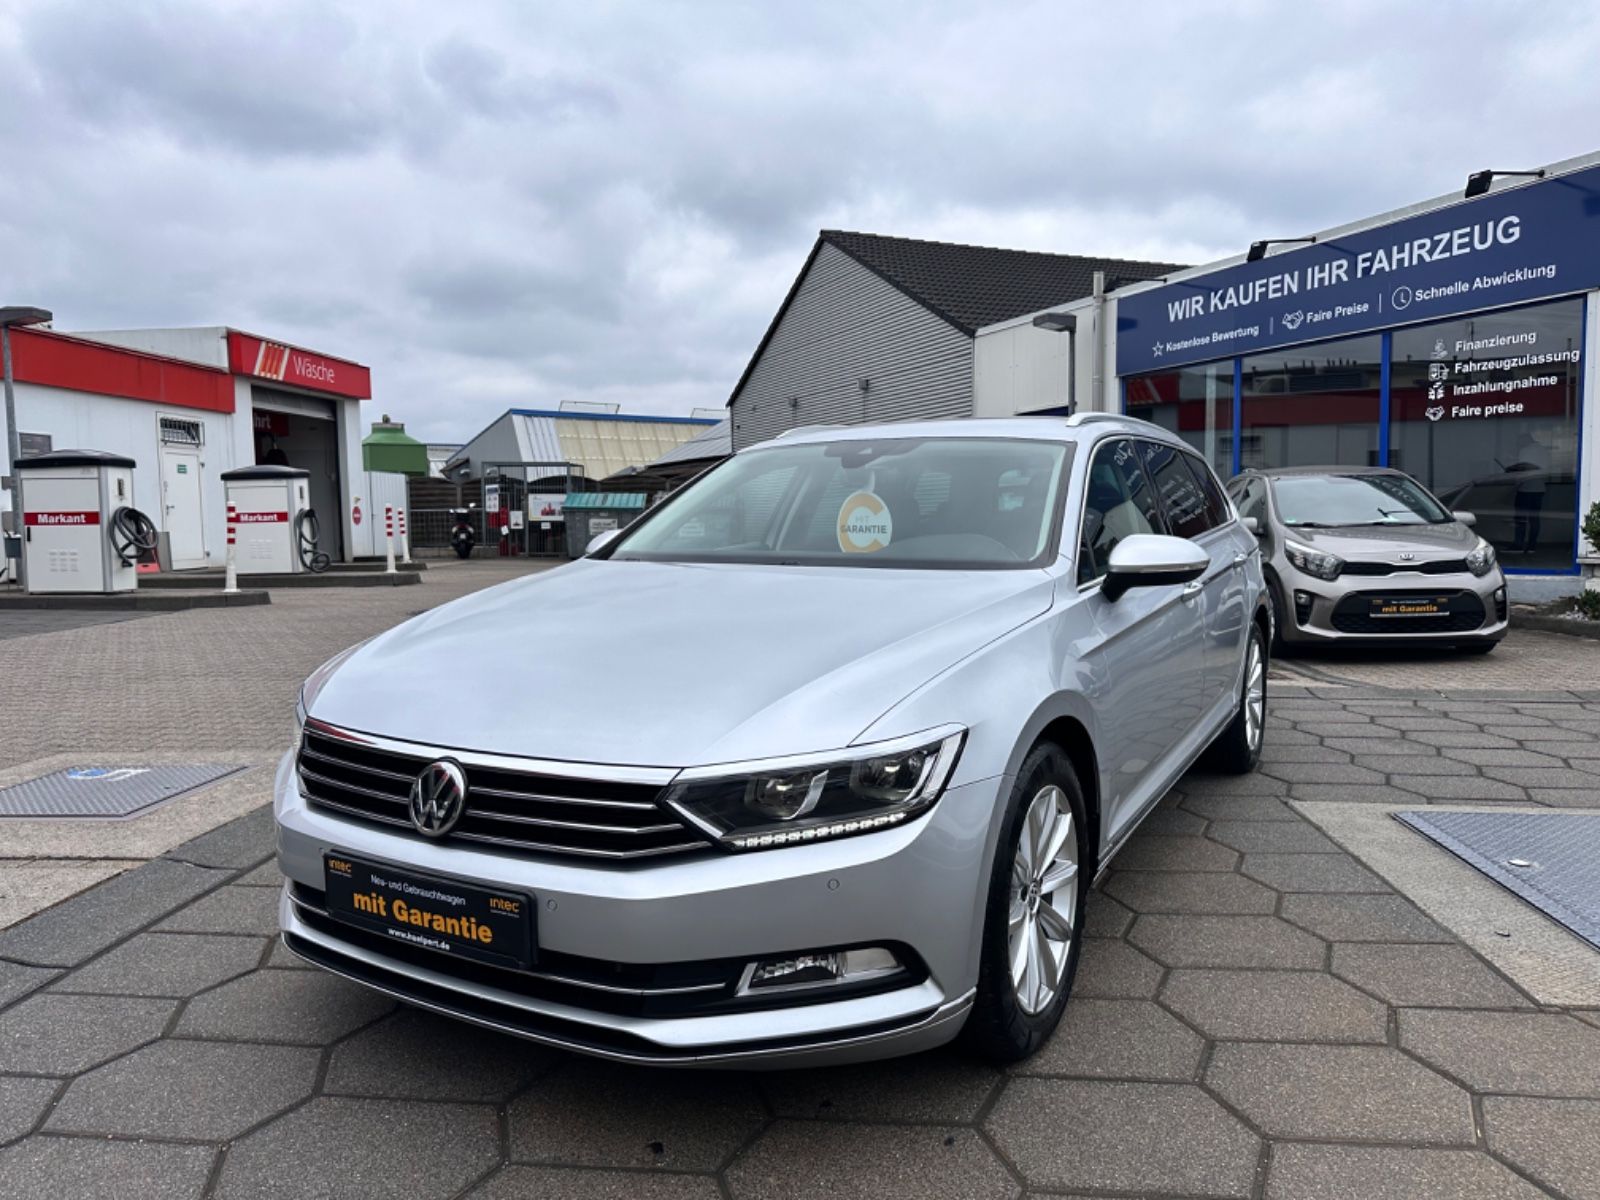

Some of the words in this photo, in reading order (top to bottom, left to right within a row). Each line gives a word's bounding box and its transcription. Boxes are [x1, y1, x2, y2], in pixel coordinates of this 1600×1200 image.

[1168, 296, 1205, 323] WIR
[1210, 271, 1299, 313] KAUFEN
[1306, 259, 1349, 290] IHR
[1356, 215, 1521, 279] FAHRZEUG
[1415, 281, 1469, 301] Schnelle
[1472, 264, 1557, 290] Abwicklung
[1306, 308, 1333, 324] Faire
[1334, 301, 1369, 316] Preise
[1166, 336, 1210, 352] Kostenlose
[1212, 325, 1260, 342] Bewertung
[1455, 332, 1537, 352] Finanzierung
[292, 354, 335, 384] Wäsche
[1454, 350, 1580, 374] Fahrzeugzulassung
[1453, 375, 1558, 396] Inzahlungnahme
[1451, 405, 1482, 418] Faire
[1485, 401, 1524, 417] preise
[37, 513, 87, 524] Markant
[240, 512, 278, 522] Markant
[840, 524, 888, 534] GARANTIE
[1382, 605, 1398, 613] mit
[1399, 604, 1439, 613] Garantie
[403, 882, 466, 906] Gebrauchtwagen
[353, 892, 387, 917] mit
[392, 899, 493, 943] Garantie
